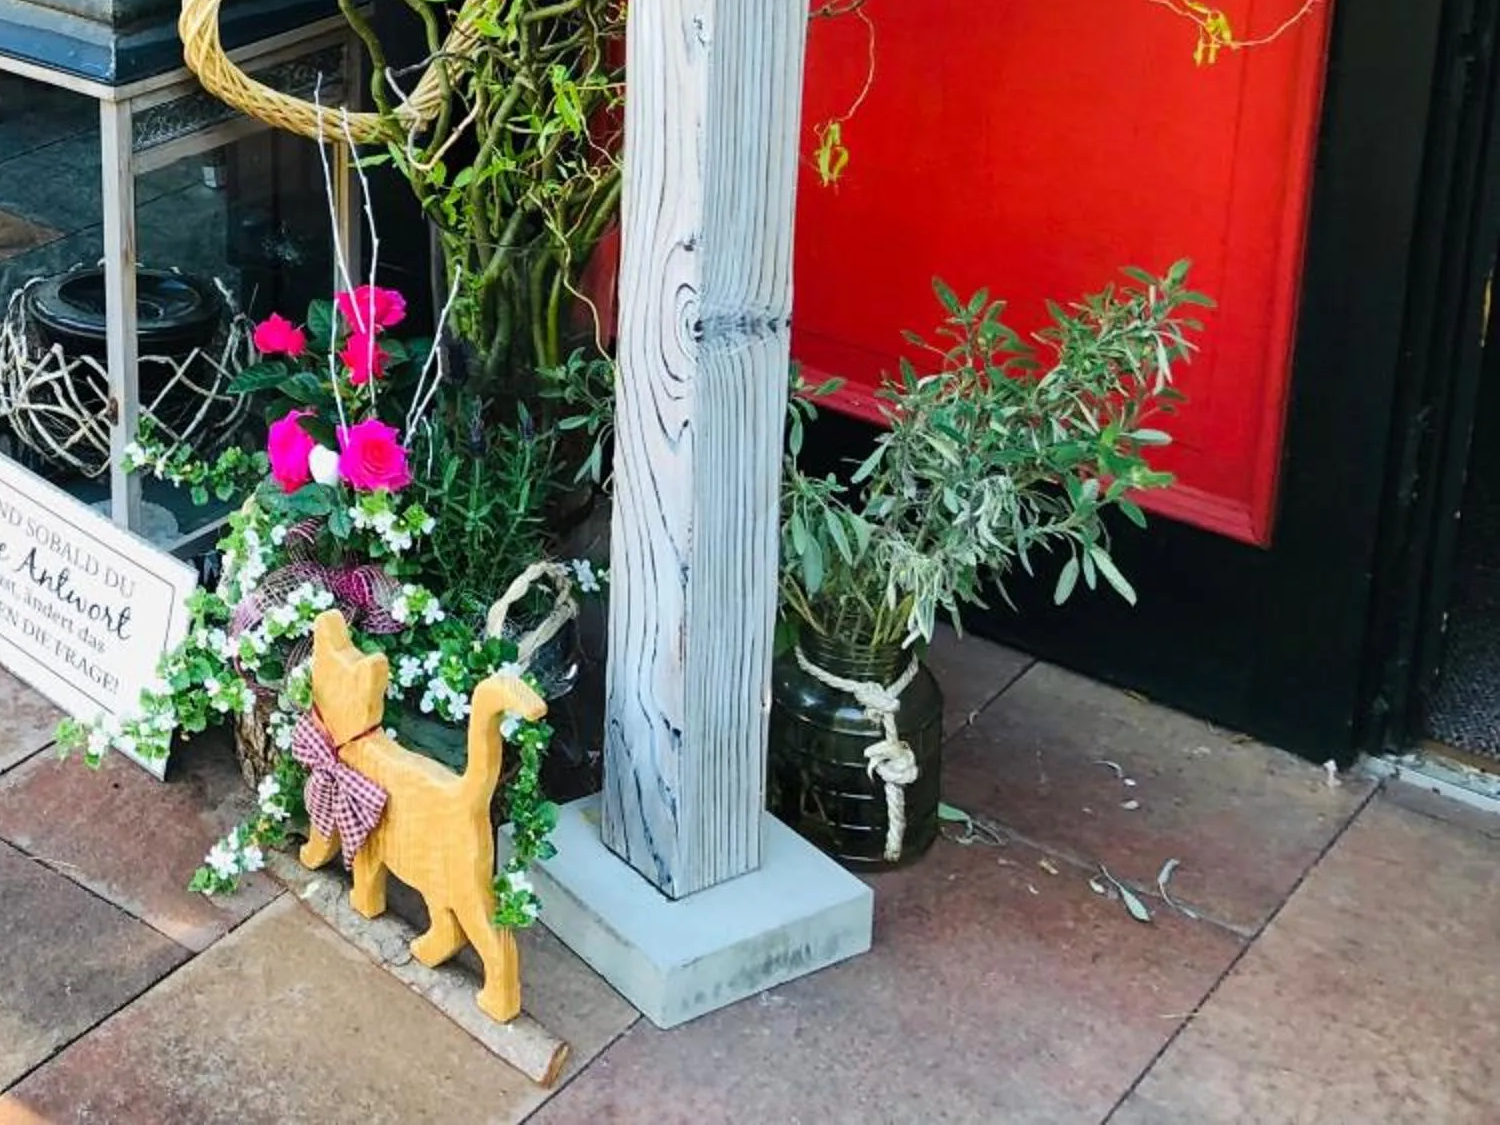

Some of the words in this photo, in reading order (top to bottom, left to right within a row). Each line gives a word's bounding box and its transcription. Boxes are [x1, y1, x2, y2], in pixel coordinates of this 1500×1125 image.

[14, 547, 132, 640] Antwort
[26, 517, 99, 576] SOBALD
[104, 567, 134, 599] DU
[23, 618, 49, 648] DIE
[55, 639, 119, 694] FRAGE!
[78, 626, 105, 653] das
